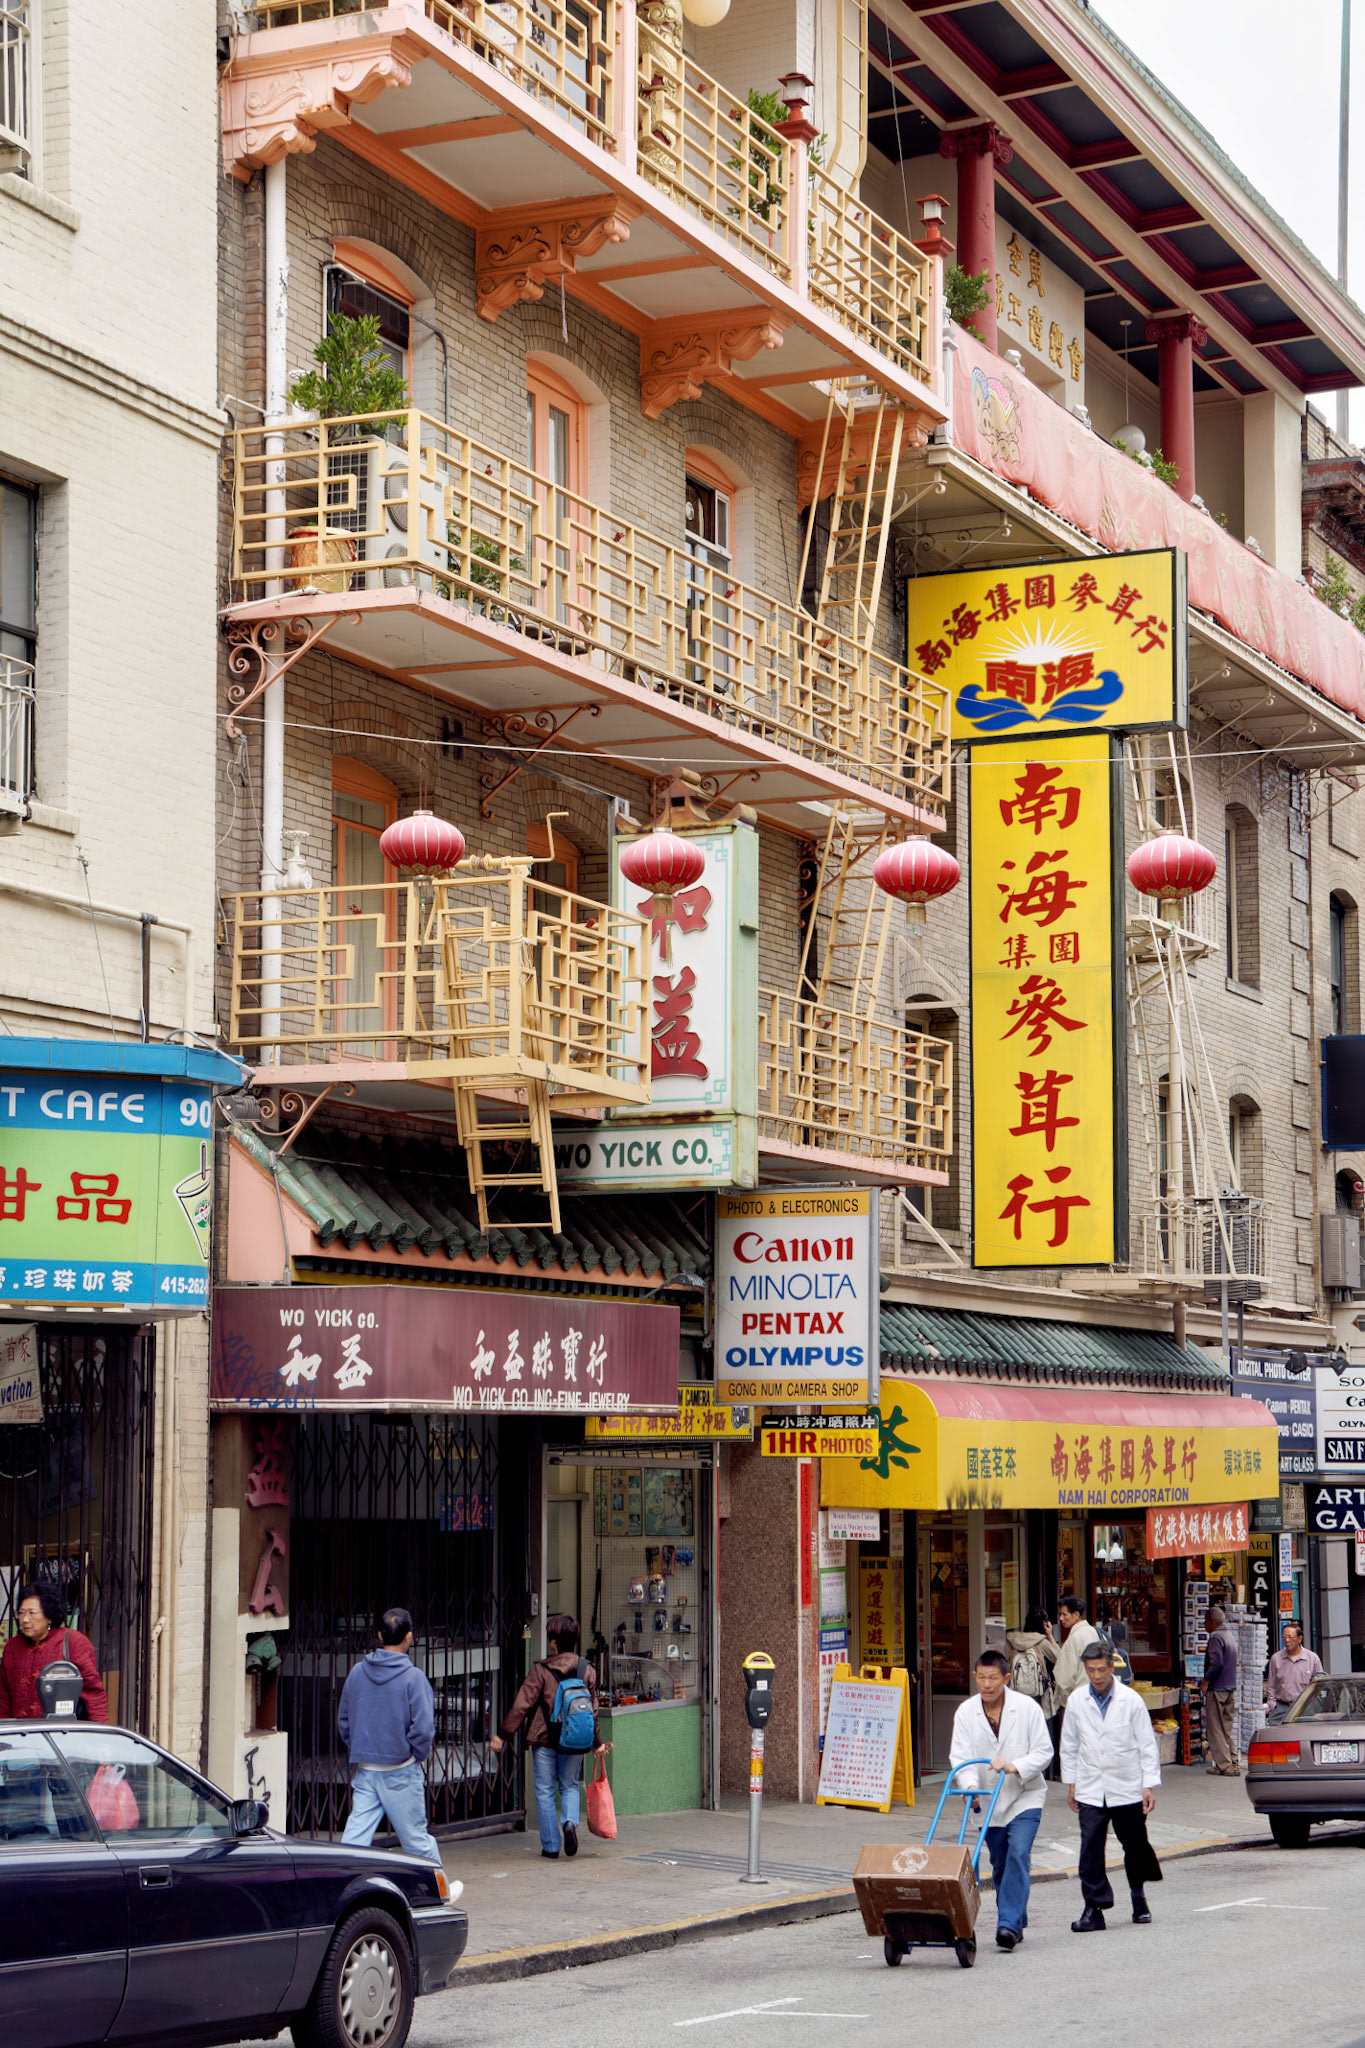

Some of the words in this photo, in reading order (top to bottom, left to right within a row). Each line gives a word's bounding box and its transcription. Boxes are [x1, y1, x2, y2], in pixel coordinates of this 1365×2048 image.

[914, 572, 1168, 676] 南海集團參茸行
[985, 652, 1095, 705] 南海
[39, 1089, 145, 1123] CAFE
[556, 1143, 591, 1169] WO
[599, 1140, 663, 1168] YICK
[672, 1138, 713, 1166] CO.
[727, 1201, 764, 1215] PHOTO
[768, 1200, 776, 1214] &
[782, 1198, 859, 1213] ELECTRONICS
[733, 1231, 853, 1264] Canon
[161, 1276, 208, 1295] 415-262-
[730, 1273, 857, 1301] MINOLTA
[280, 1309, 305, 1327] WO
[315, 1309, 353, 1327] YICK
[357, 1312, 379, 1329] CO.
[742, 1311, 844, 1335] PENTAX
[0, 1335, 31, 1363] 首家
[470, 1327, 608, 1387] 和益珠寶行
[726, 1346, 864, 1367] OLYMPUS
[279, 1333, 373, 1390] 和益
[1237, 1358, 1264, 1378] DIGITAL
[1264, 1362, 1286, 1379] PHOTO
[1, 1376, 32, 1405] vation
[728, 1383, 757, 1397] GONG
[761, 1383, 782, 1397] NUM
[787, 1382, 826, 1397] CAMERA
[832, 1382, 859, 1397] SHOP
[1339, 1377, 1365, 1387] SO
[453, 1386, 472, 1408] WO
[479, 1387, 507, 1409] YICK
[585, 1391, 631, 1410] JEWELRY
[687, 1387, 711, 1406] CAMERA
[1265, 1398, 1288, 1413] Canon
[1289, 1399, 1312, 1415] PENTAX
[764, 1414, 876, 1429] 一小時冲晒照片
[1292, 1423, 1314, 1437] CASIO
[766, 1431, 817, 1455] 1HR
[820, 1437, 873, 1455] PHOTOS
[1328, 1440, 1355, 1460] SAN
[1357, 1440, 1365, 1460] F
[967, 1446, 1017, 1480] 國產茗茶
[1050, 1432, 1198, 1485] 南海集團參茸行
[1280, 1456, 1293, 1473] ART
[1293, 1457, 1315, 1473] GLASS
[1058, 1488, 1084, 1505] NAM
[1087, 1489, 1107, 1505] HAI
[1110, 1486, 1190, 1505] CORPORATION
[1315, 1509, 1365, 1530] GA
[1250, 1541, 1271, 1550] ART
